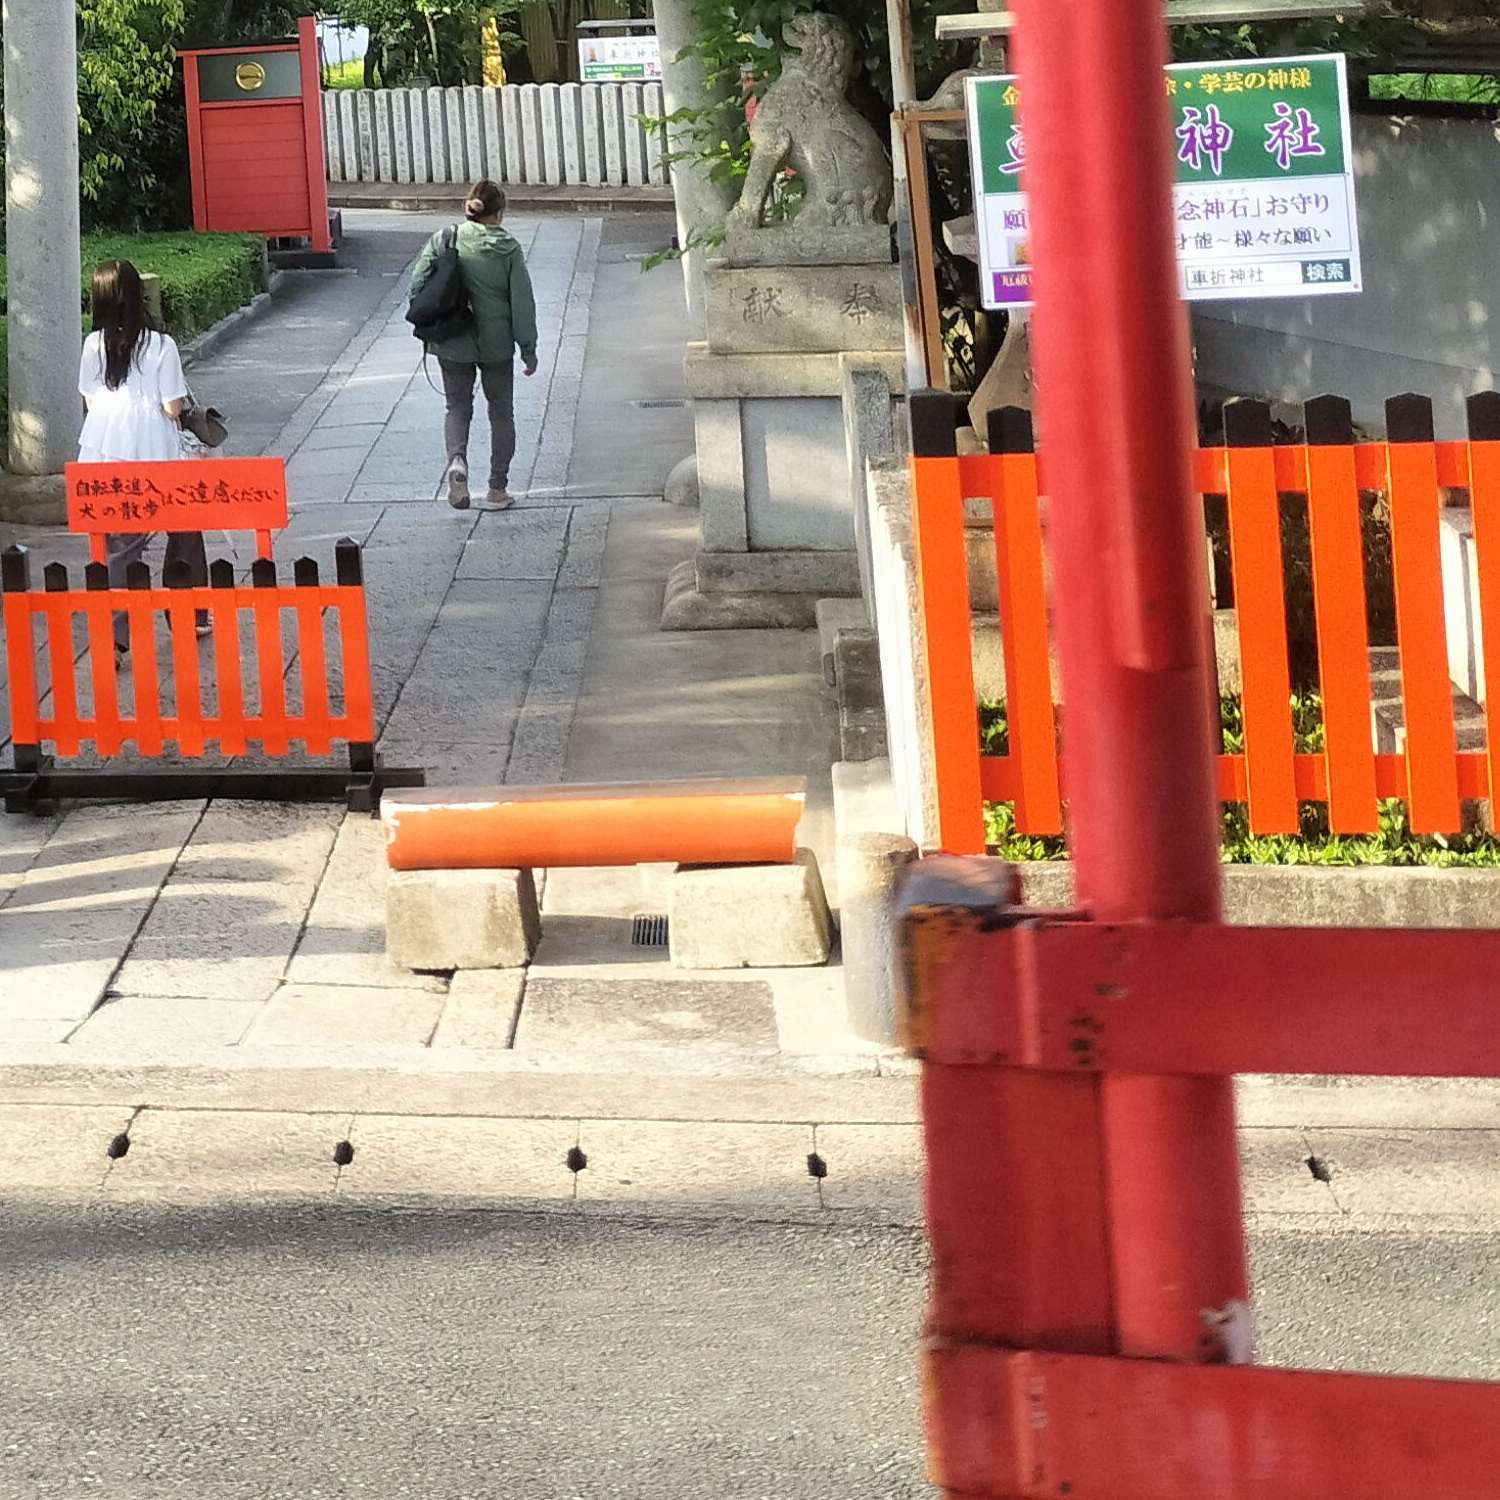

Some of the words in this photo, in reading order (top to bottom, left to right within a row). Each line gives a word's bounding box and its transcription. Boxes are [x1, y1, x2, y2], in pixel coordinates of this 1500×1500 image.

[1190, 267, 1265, 286] 車折神社
[1306, 261, 1344, 282] 検索
[76, 476, 160, 498] 自転車進入
[79, 500, 159, 521] 犬の散歩
